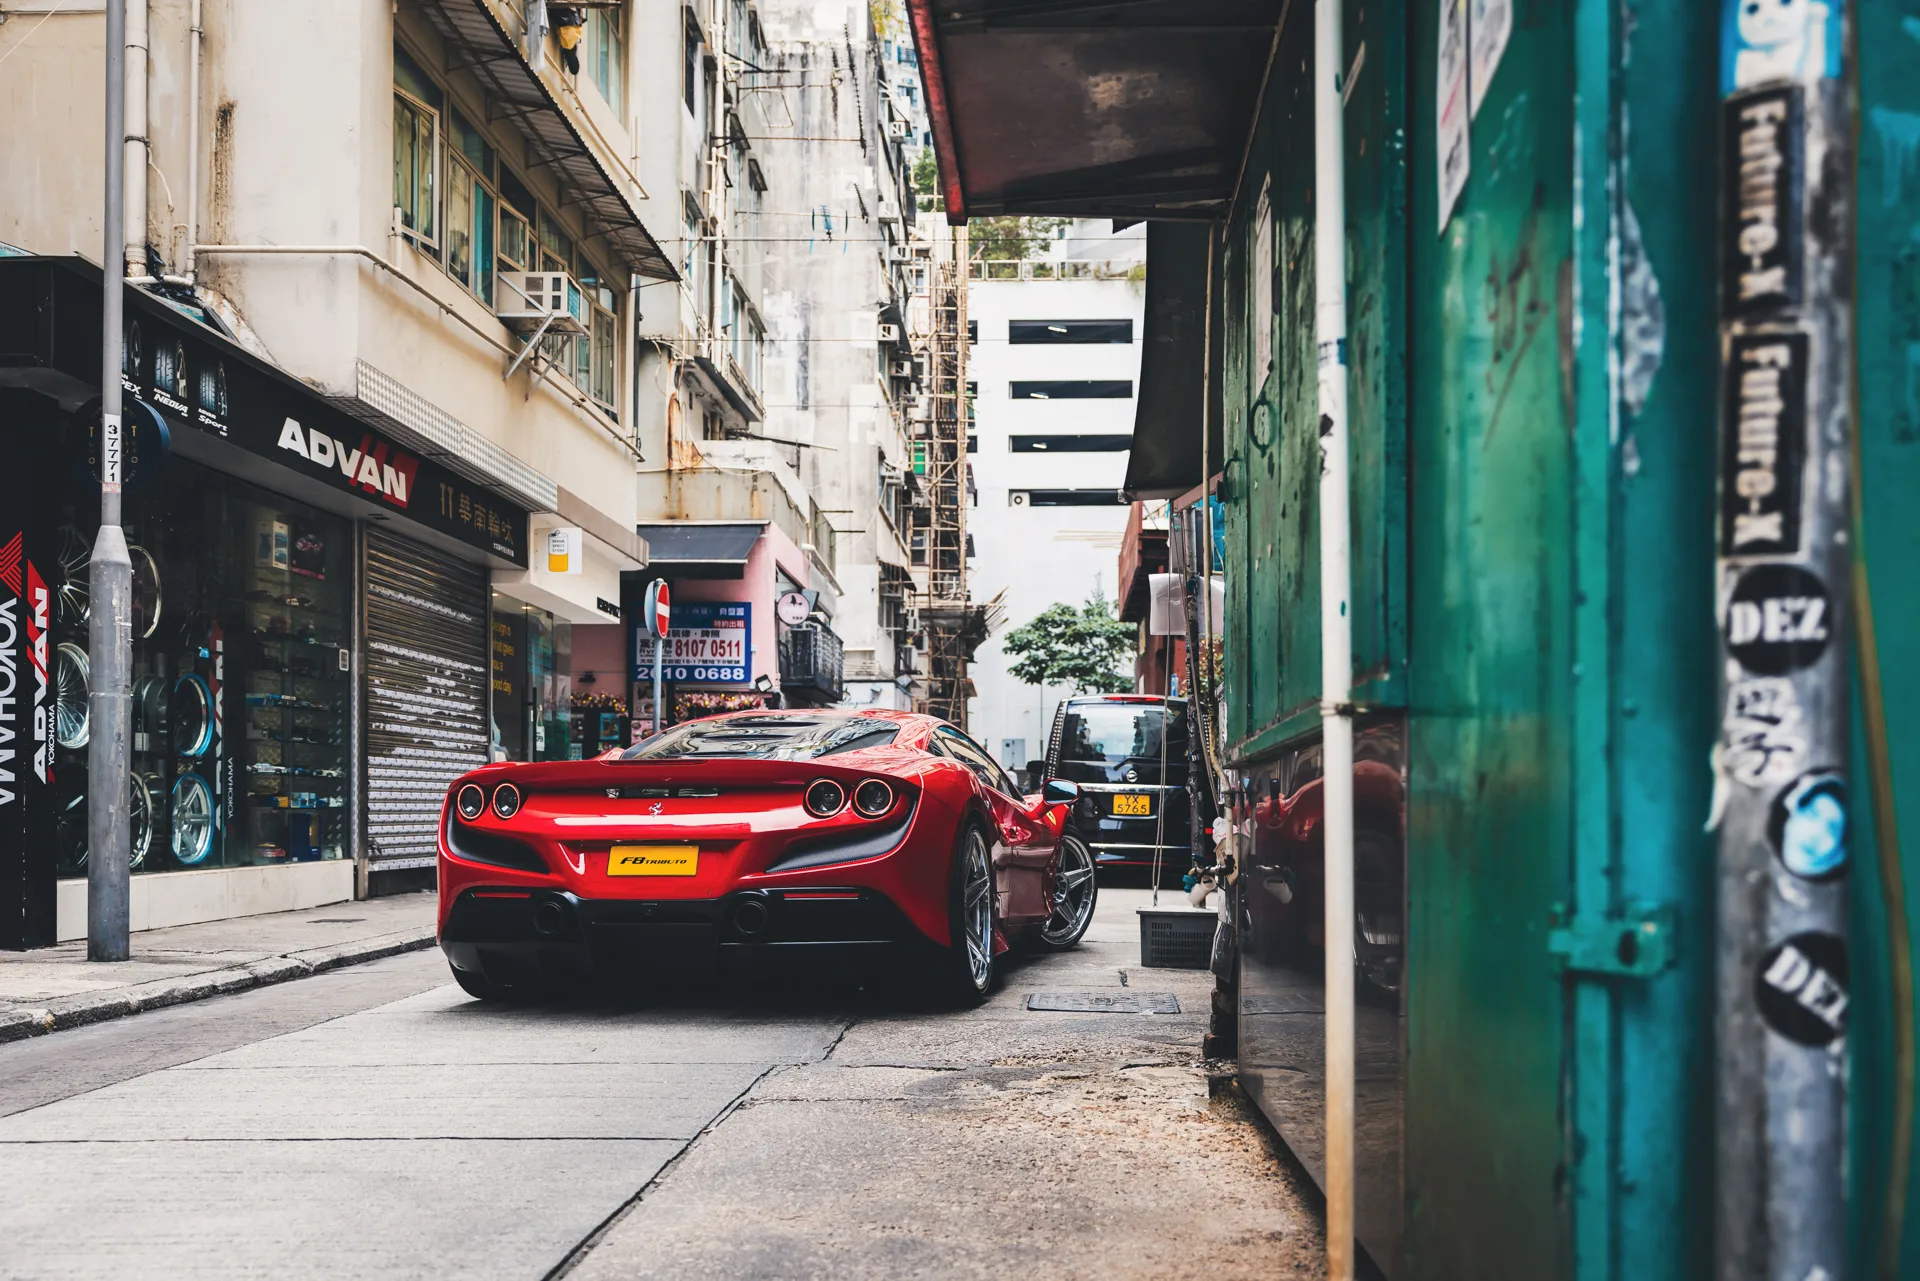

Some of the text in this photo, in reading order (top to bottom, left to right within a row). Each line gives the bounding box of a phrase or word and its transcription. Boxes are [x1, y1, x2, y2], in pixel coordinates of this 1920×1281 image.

[121, 379, 142, 395] PEX
[153, 394, 189, 414] NEOVA
[198, 415, 228, 432] Sport
[107, 425, 119, 482] 37771
[277, 417, 407, 503] ADVAN
[1730, 597, 1827, 644] DEZ
[675, 639, 707, 657] 8107
[711, 639, 741, 657] 0511
[694, 667, 745, 680] 0688
[33, 587, 48, 785] ADVAN
[1116, 804, 1147, 814] 5765
[1124, 795, 1139, 804] YX
[1763, 945, 1849, 1028] DEZ
